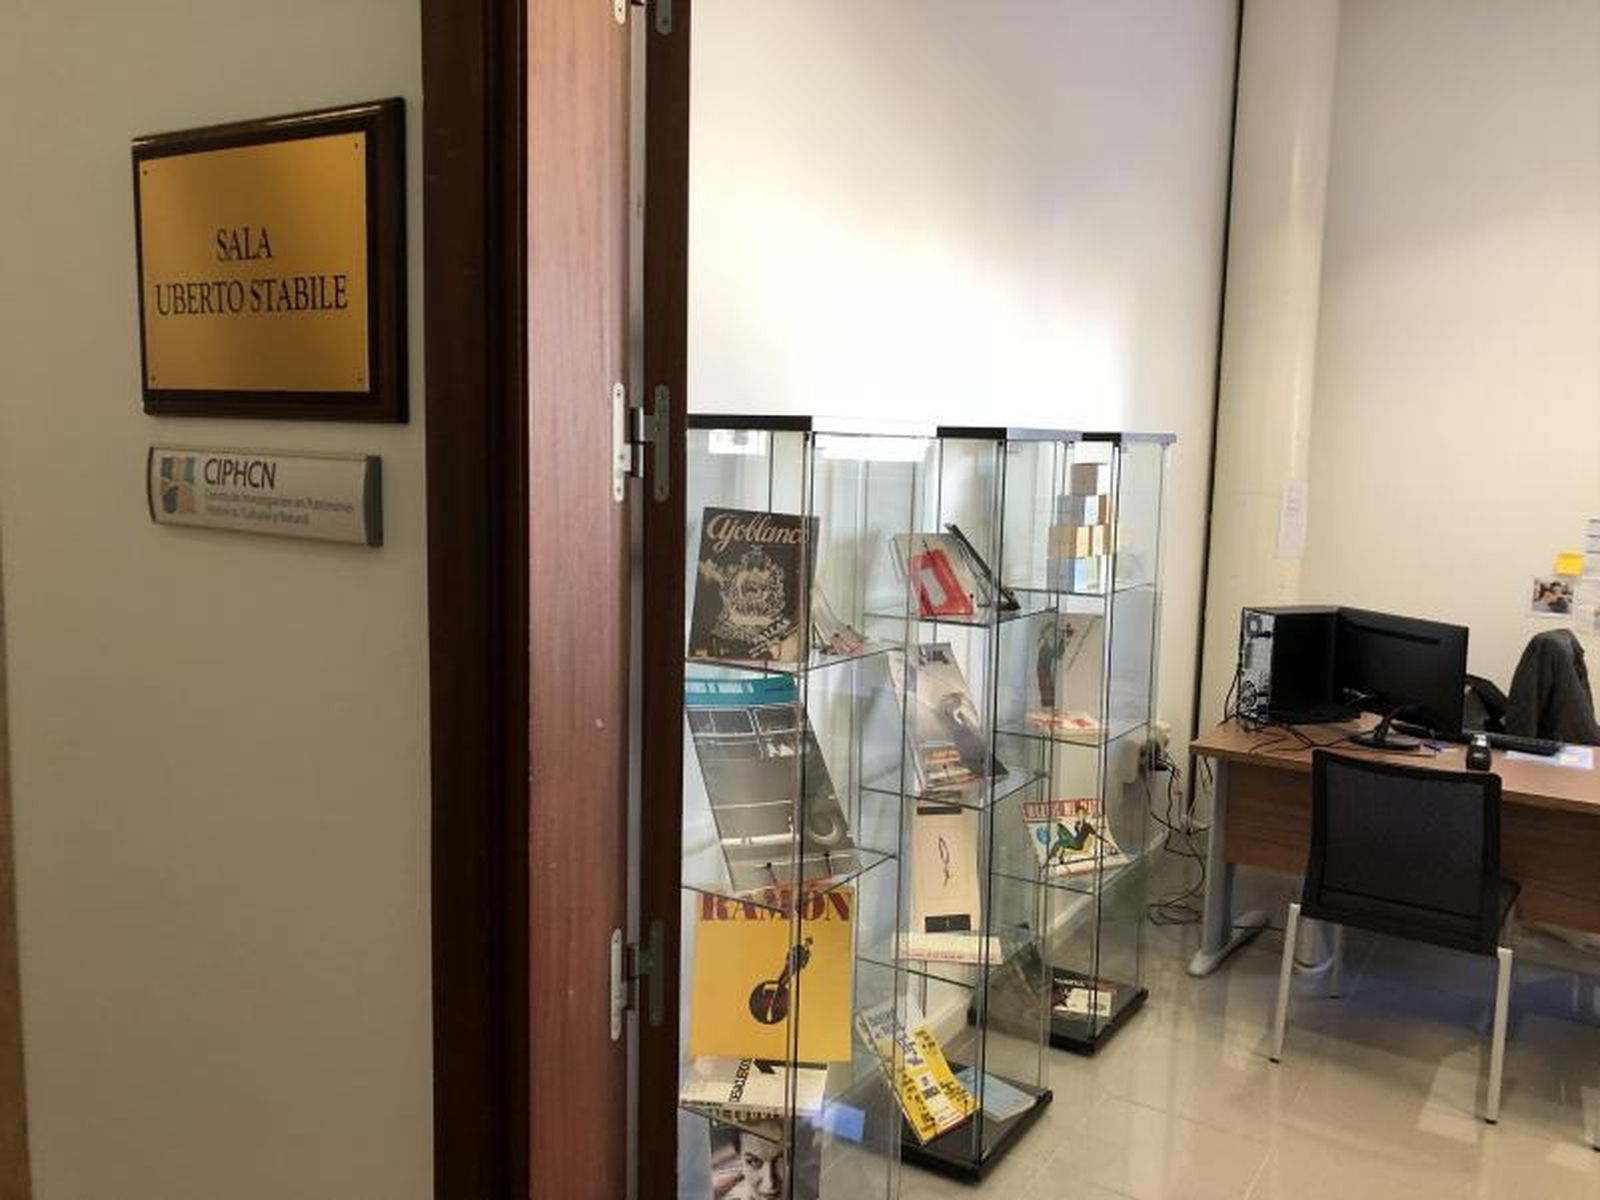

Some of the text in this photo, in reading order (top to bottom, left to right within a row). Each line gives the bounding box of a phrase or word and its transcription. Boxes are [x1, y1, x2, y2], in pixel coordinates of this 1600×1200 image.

[216, 226, 273, 262] SALA
[155, 274, 349, 316] UBERTO STABILE
[204, 458, 276, 490] CIPHCN
